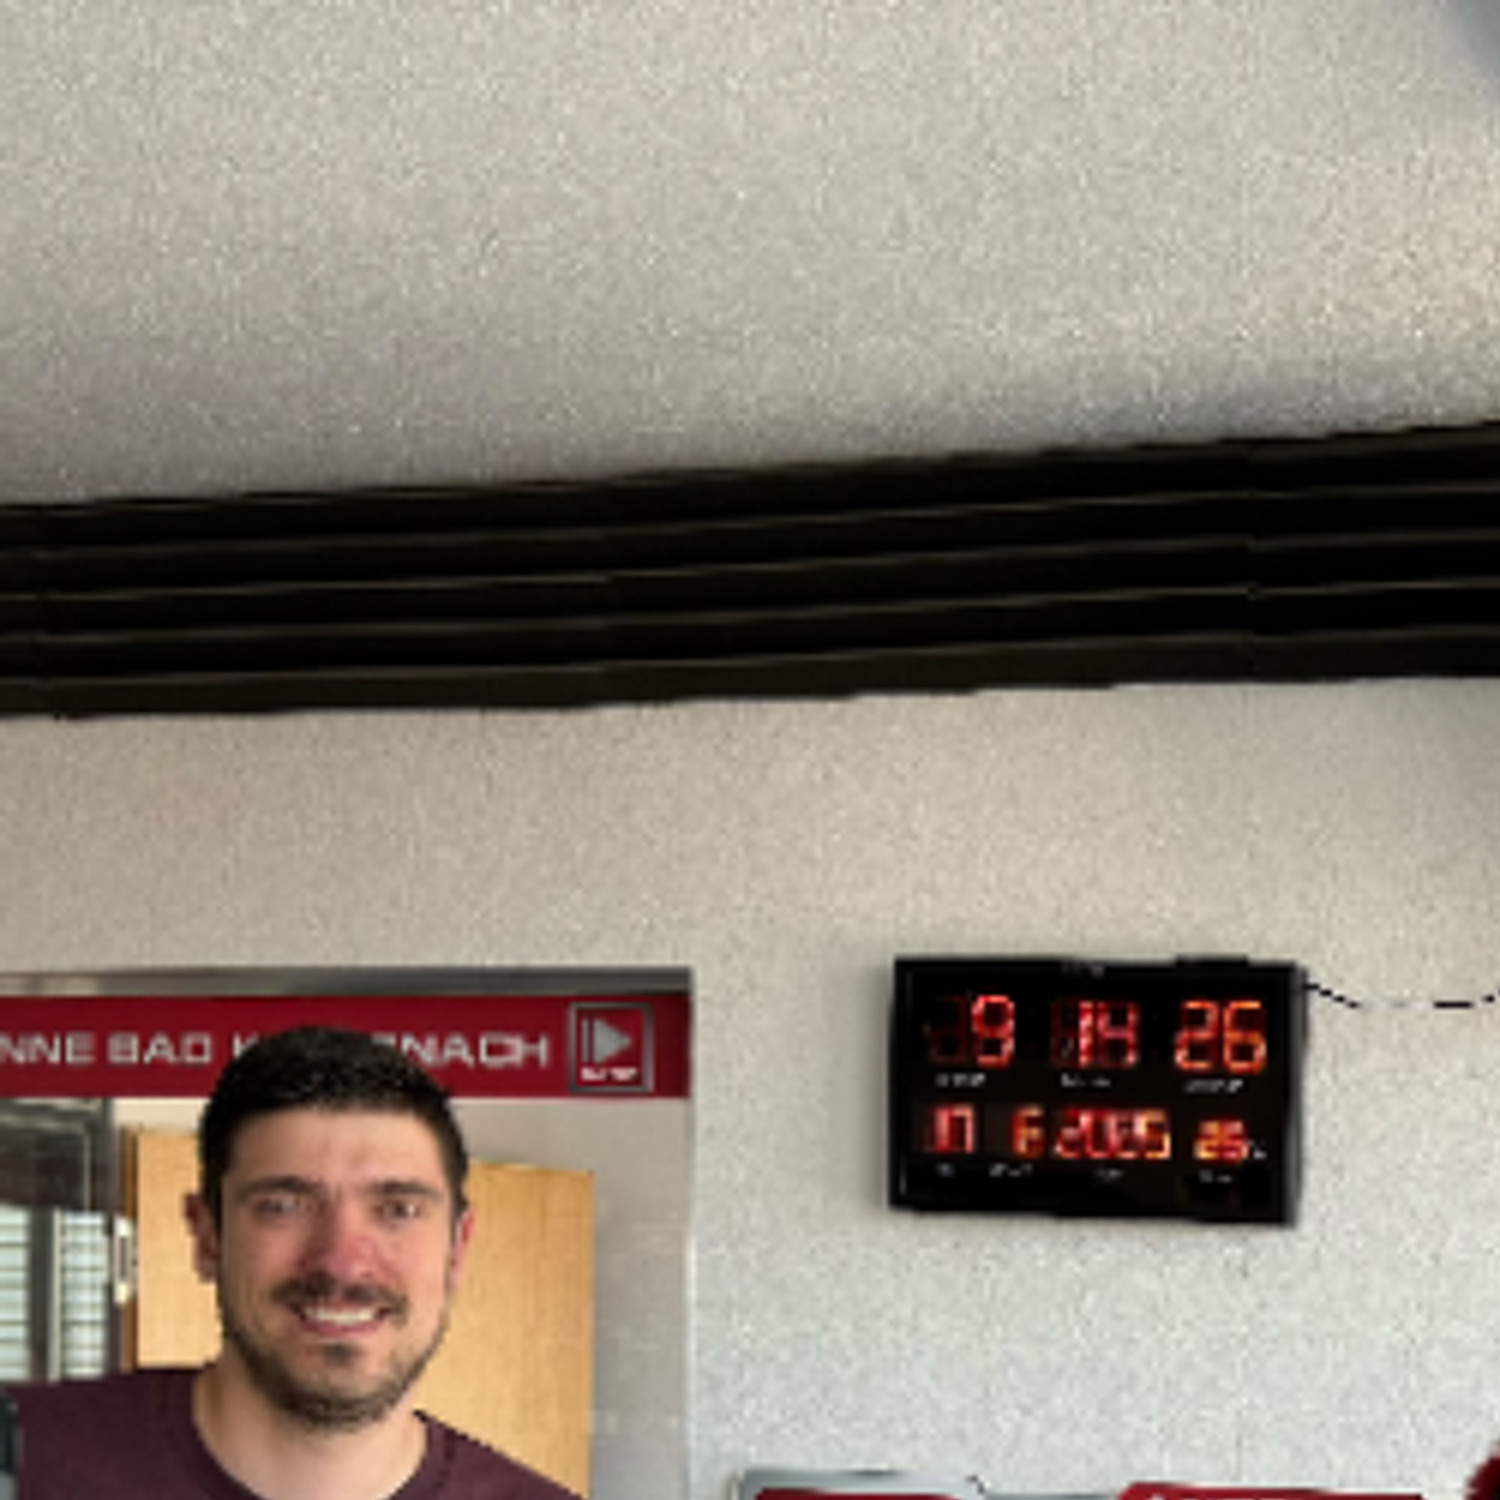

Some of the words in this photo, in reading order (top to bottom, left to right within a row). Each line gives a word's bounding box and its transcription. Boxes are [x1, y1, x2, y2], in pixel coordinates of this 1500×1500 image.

[107, 1031, 213, 1064] BAD
[971, 994, 1015, 1068] 9
[1174, 1000, 1266, 1073] 26
